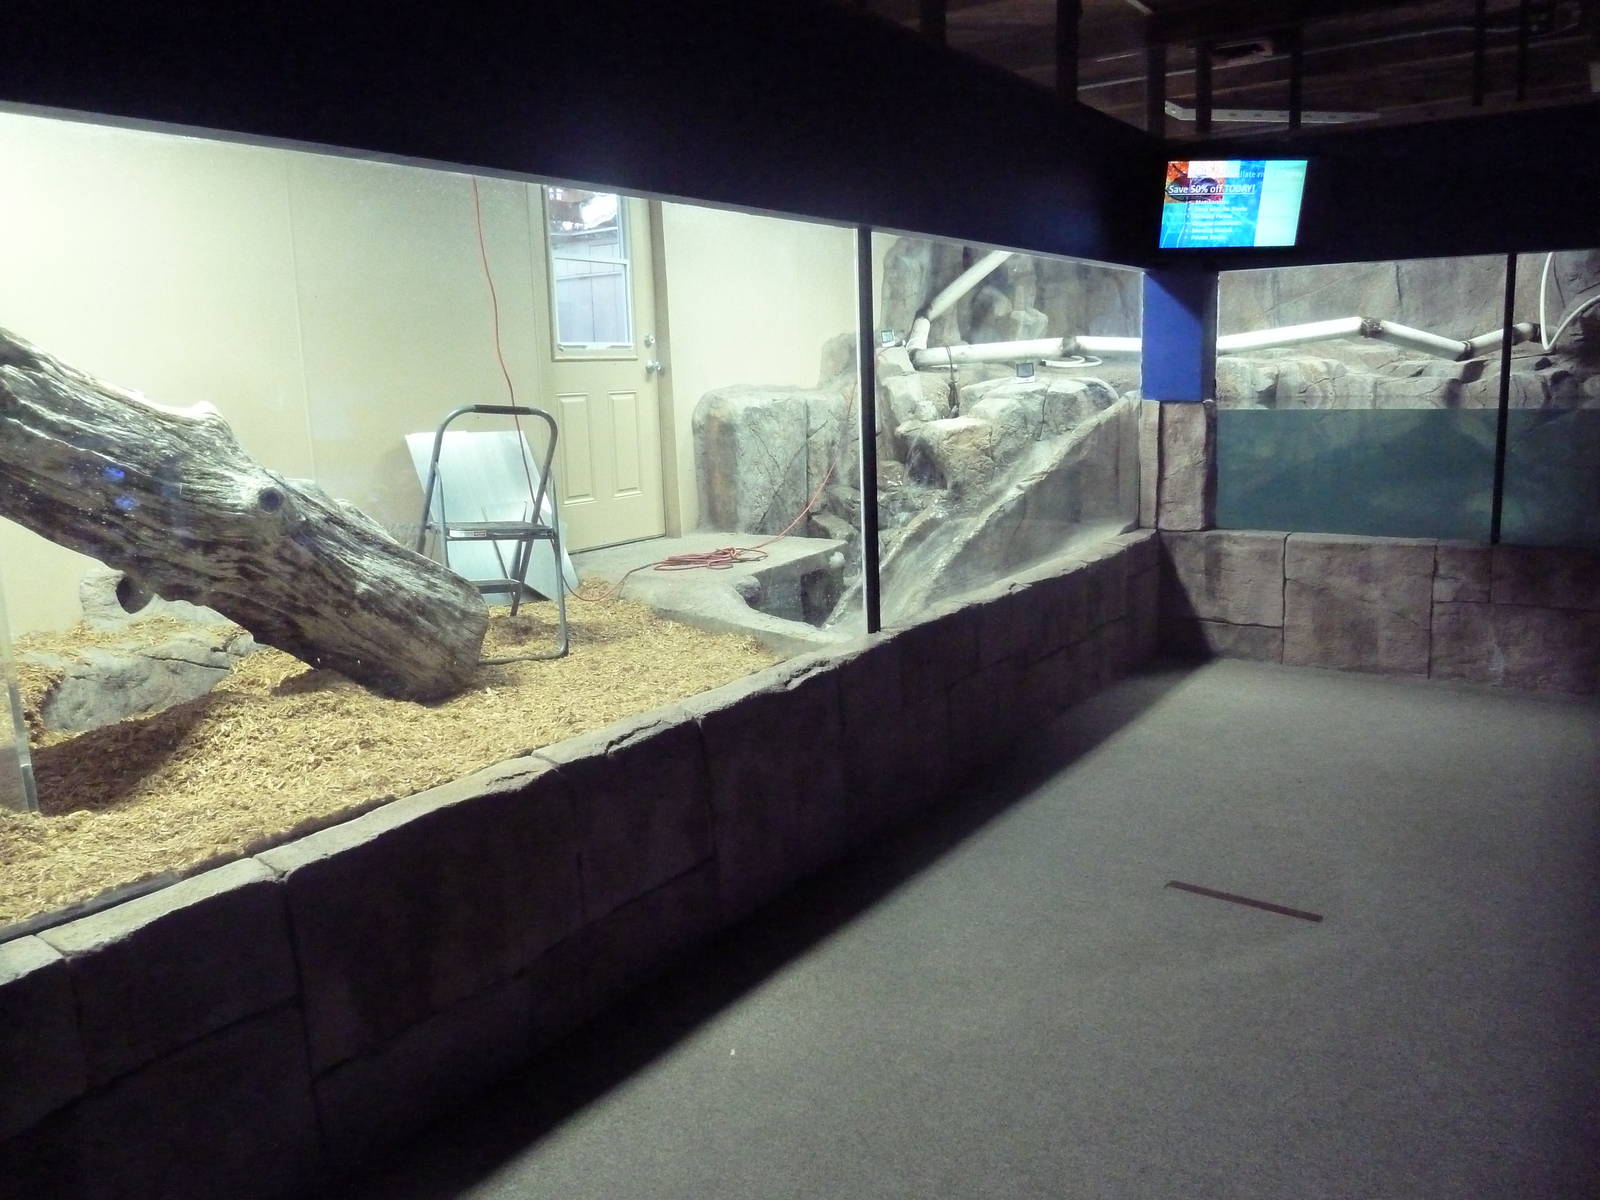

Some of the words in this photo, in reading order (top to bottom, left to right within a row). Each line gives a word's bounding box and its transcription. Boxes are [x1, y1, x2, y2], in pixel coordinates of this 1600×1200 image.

[1168, 185, 1189, 194] Save
[1190, 184, 1208, 193] 50%
[1209, 184, 1224, 193] off
[1224, 183, 1256, 193] TODAY!
